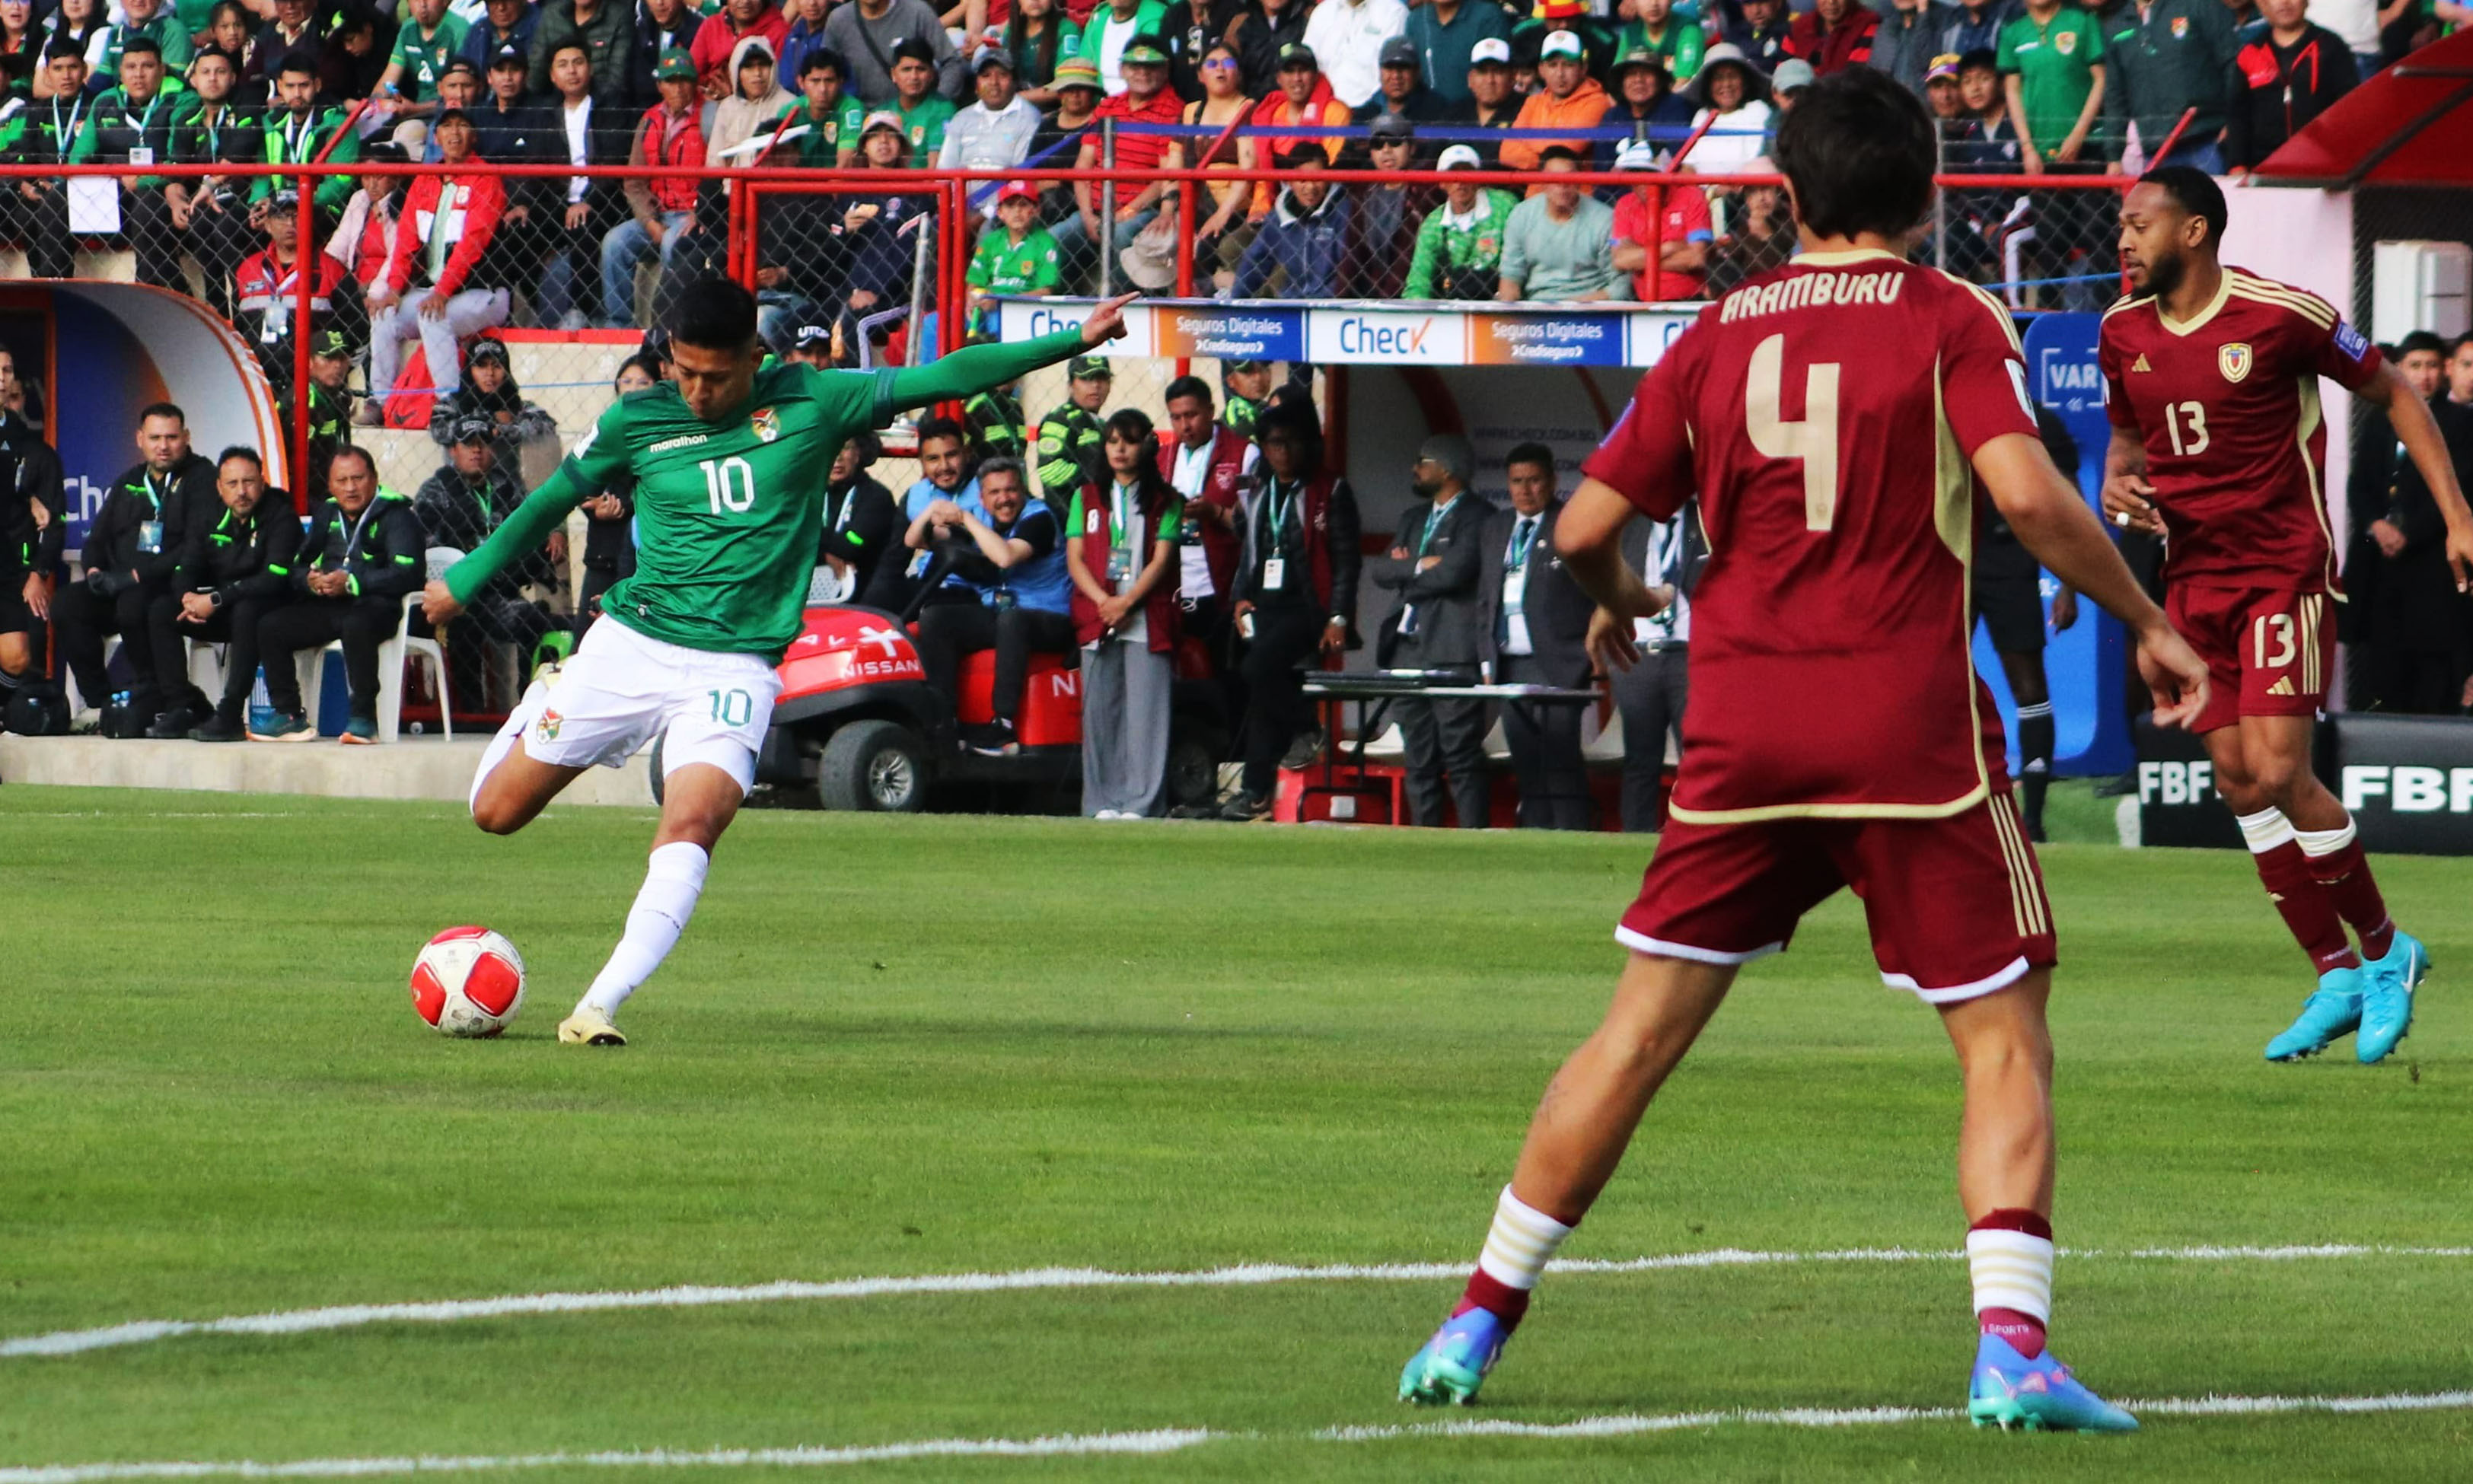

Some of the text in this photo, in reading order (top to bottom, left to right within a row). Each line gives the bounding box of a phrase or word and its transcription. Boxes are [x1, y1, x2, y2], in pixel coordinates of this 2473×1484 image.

[1719, 272, 1904, 323] ARAMBURU
[1176, 316, 1283, 337] Seguros Digitales
[1340, 317, 1432, 355] Check
[1492, 321, 1603, 342] Seguros Digitales
[2051, 364, 2099, 388] VAR
[650, 435, 708, 453] marathon
[1745, 333, 1840, 530] 4
[2165, 401, 2209, 456] 13
[700, 457, 754, 514] 10
[1087, 508, 1099, 533] 8
[2254, 613, 2296, 668] 13
[840, 658, 919, 677] NISSAN
[707, 688, 752, 727] 10
